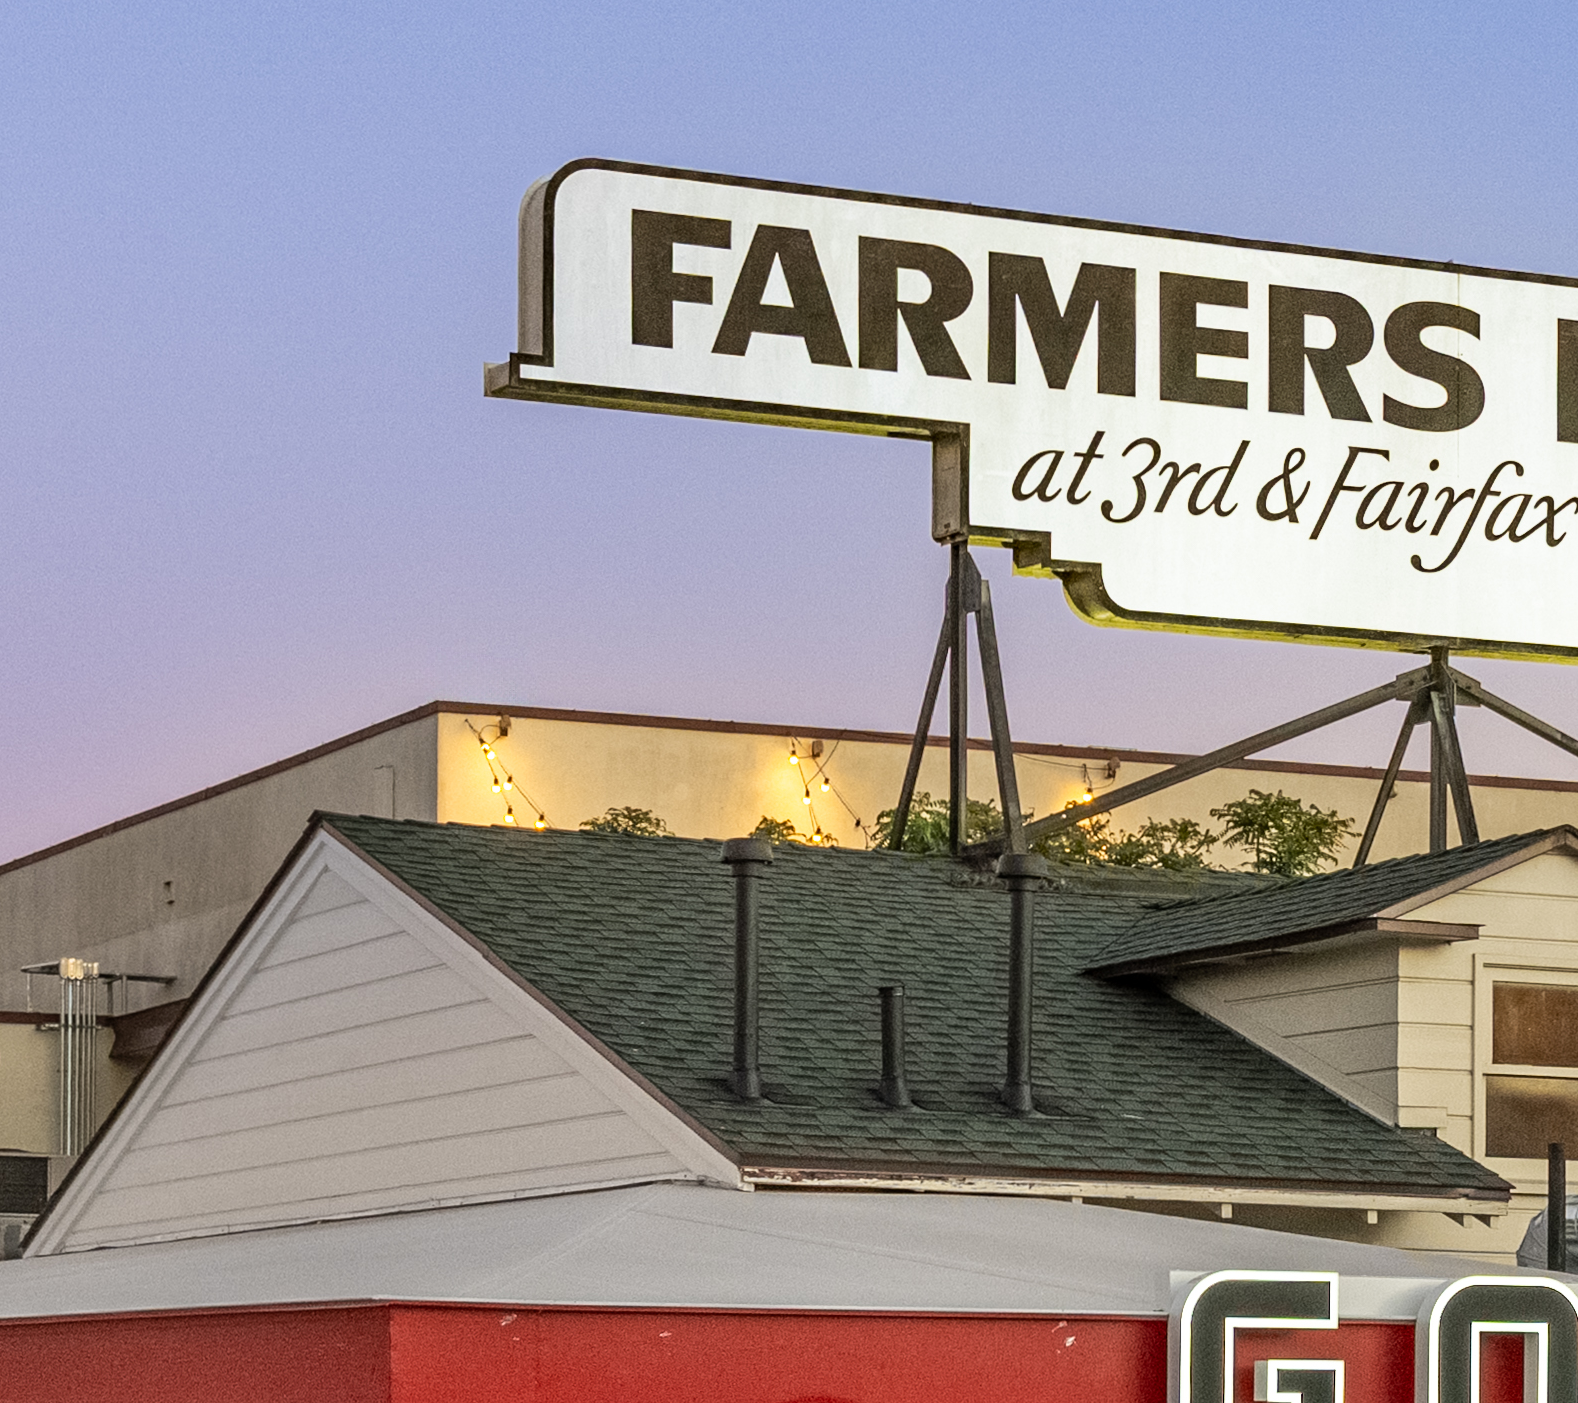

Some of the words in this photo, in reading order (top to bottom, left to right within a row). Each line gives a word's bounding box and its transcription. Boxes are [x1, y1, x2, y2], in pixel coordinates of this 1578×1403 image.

[631, 209, 1486, 433] FARMERS
[1011, 431, 1109, 502] at
[1101, 438, 1251, 523] 3rd
[1257, 448, 1310, 523] &
